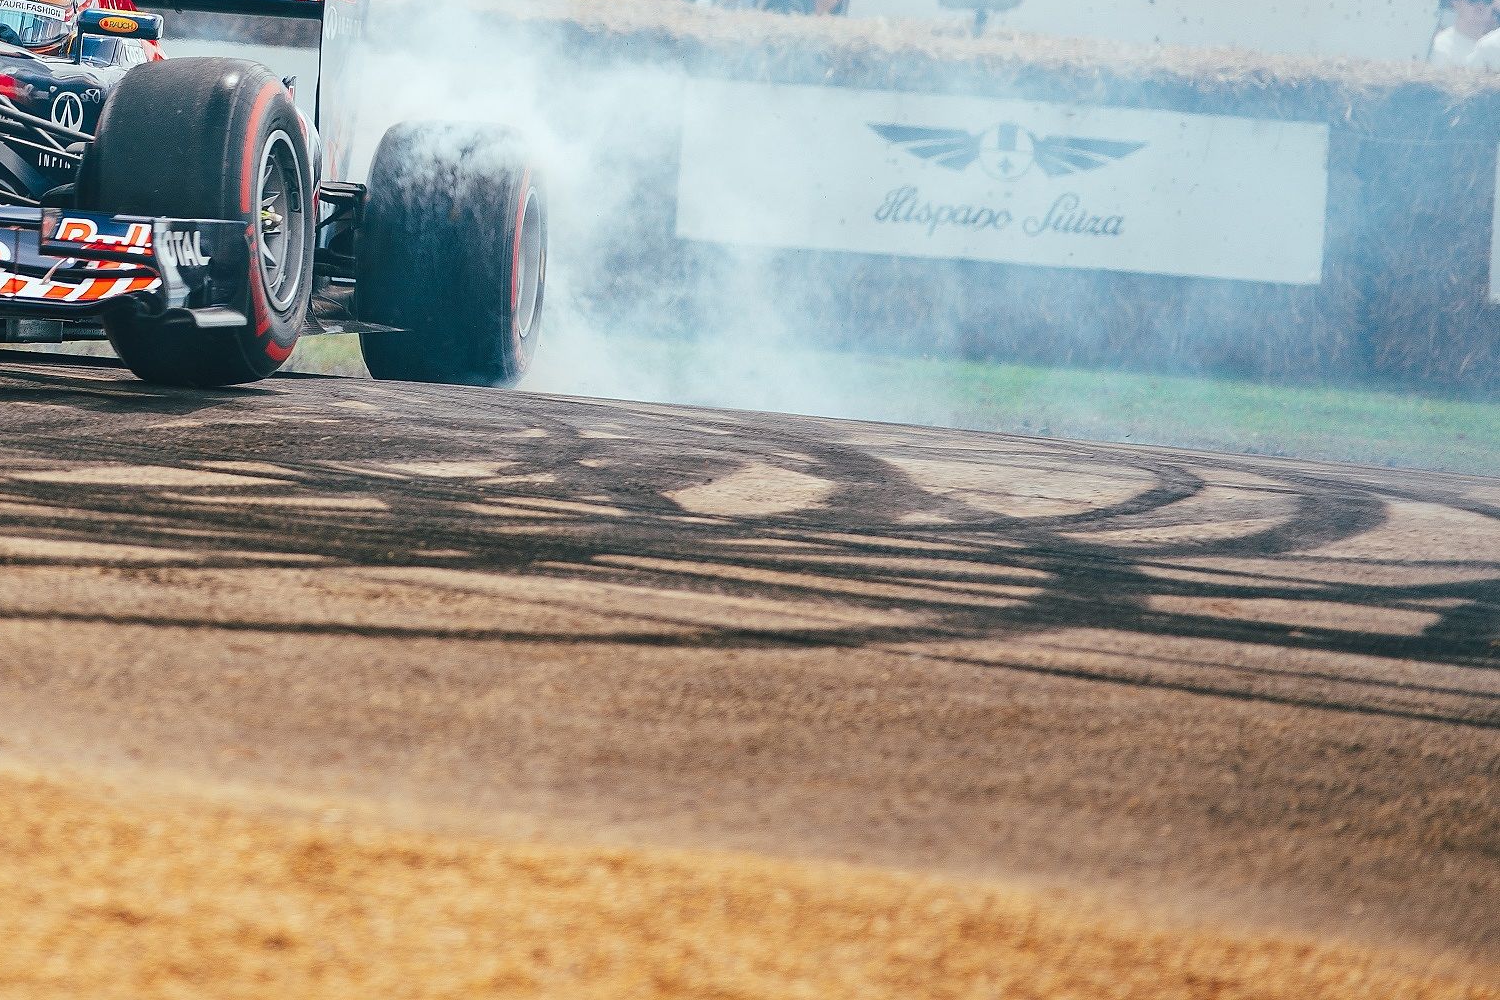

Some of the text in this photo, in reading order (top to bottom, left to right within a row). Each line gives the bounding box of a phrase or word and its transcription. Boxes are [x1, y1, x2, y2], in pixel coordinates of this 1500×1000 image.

[109, 21, 134, 30] RAUCH
[873, 185, 1125, 238] Hispano Suiza
[158, 230, 211, 266] OTAL
